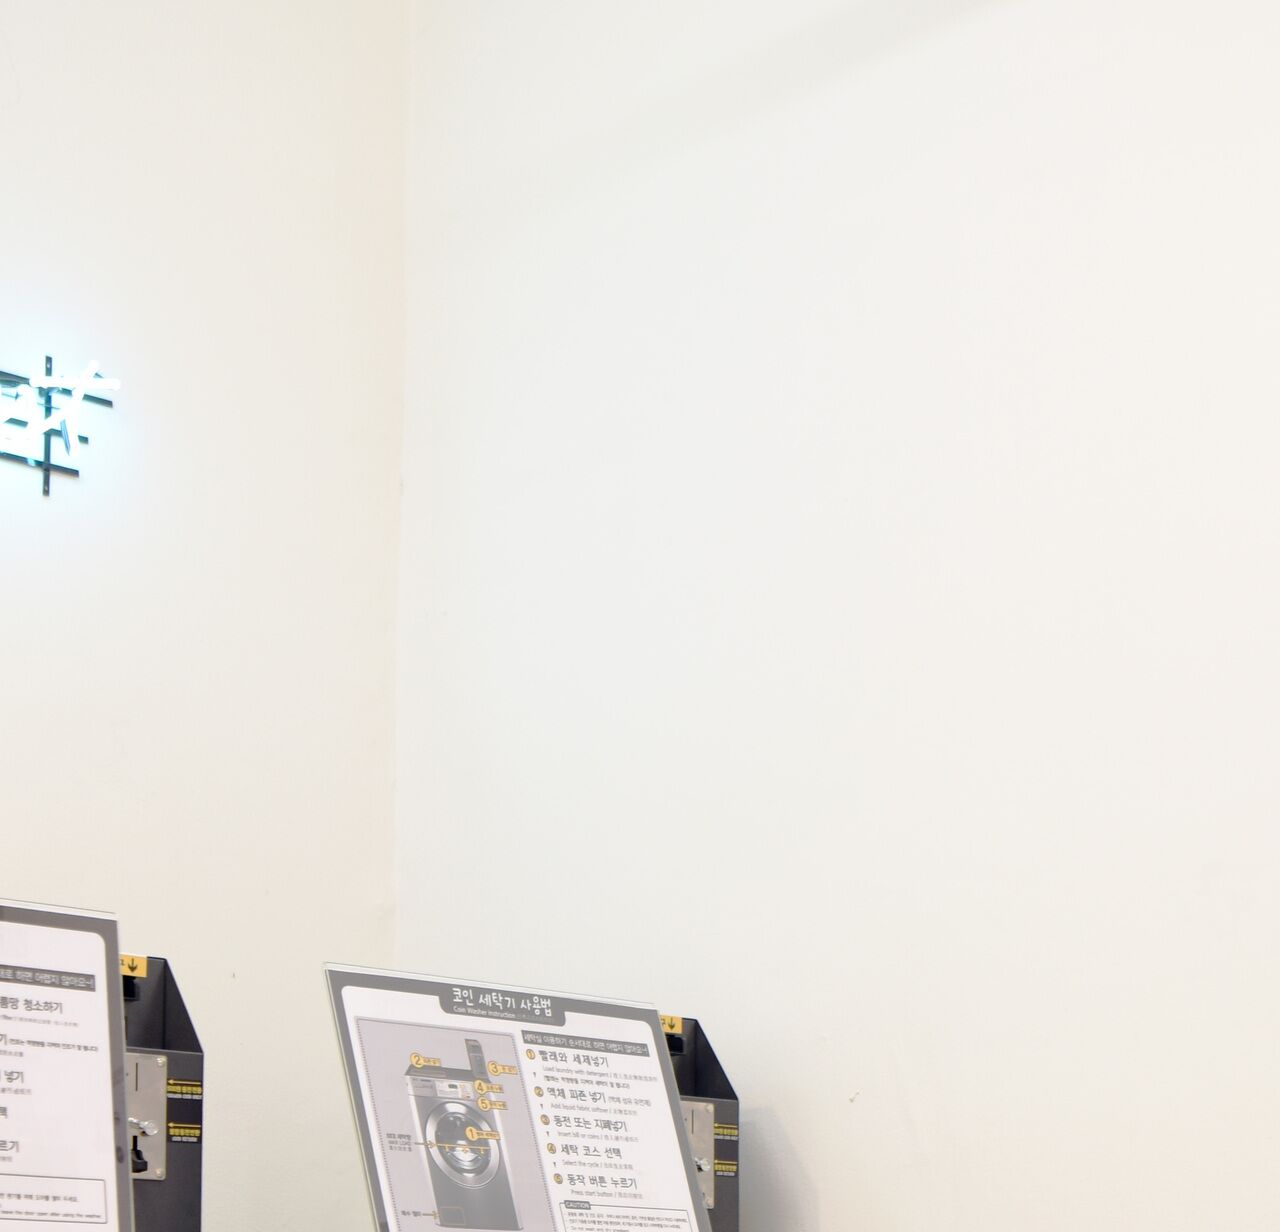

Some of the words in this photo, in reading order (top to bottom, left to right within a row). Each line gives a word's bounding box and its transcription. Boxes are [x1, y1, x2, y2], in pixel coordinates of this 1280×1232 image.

[23, 999, 63, 1015] 청소하기
[452, 987, 473, 1007] 코인
[478, 990, 515, 1011] 세탁기
[520, 996, 552, 1017] 사용법
[538, 1050, 567, 1063] 빨래와
[4, 1069, 24, 1083] 넣기
[554, 1115, 572, 1128] 동전
[574, 1116, 591, 1130] 또는
[561, 1143, 578, 1156] 세탁
[583, 1145, 601, 1157] 코스
[604, 1146, 622, 1159] 선택
[567, 1174, 585, 1186] 동작
[589, 1175, 607, 1188] 버튼
[611, 1177, 637, 1190] 누르기
